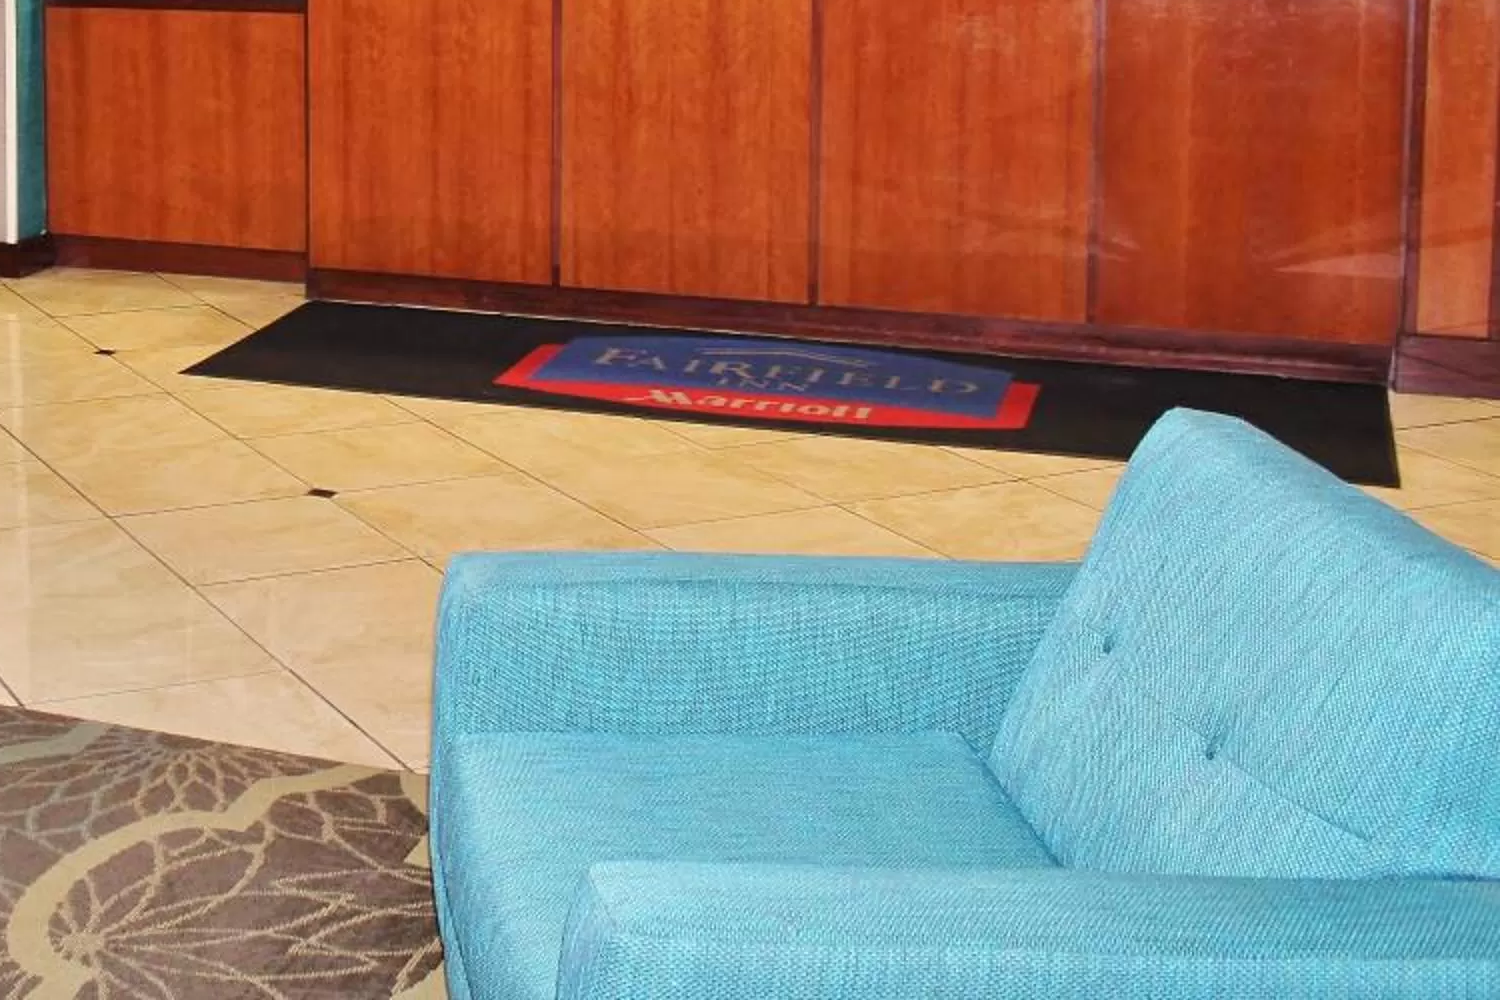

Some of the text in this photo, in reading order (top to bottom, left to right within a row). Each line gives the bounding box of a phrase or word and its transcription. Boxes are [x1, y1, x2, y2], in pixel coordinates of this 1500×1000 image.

[594, 347, 979, 393] FAIRFIELD
[716, 377, 810, 392] INN
[624, 389, 872, 419] Marriott
